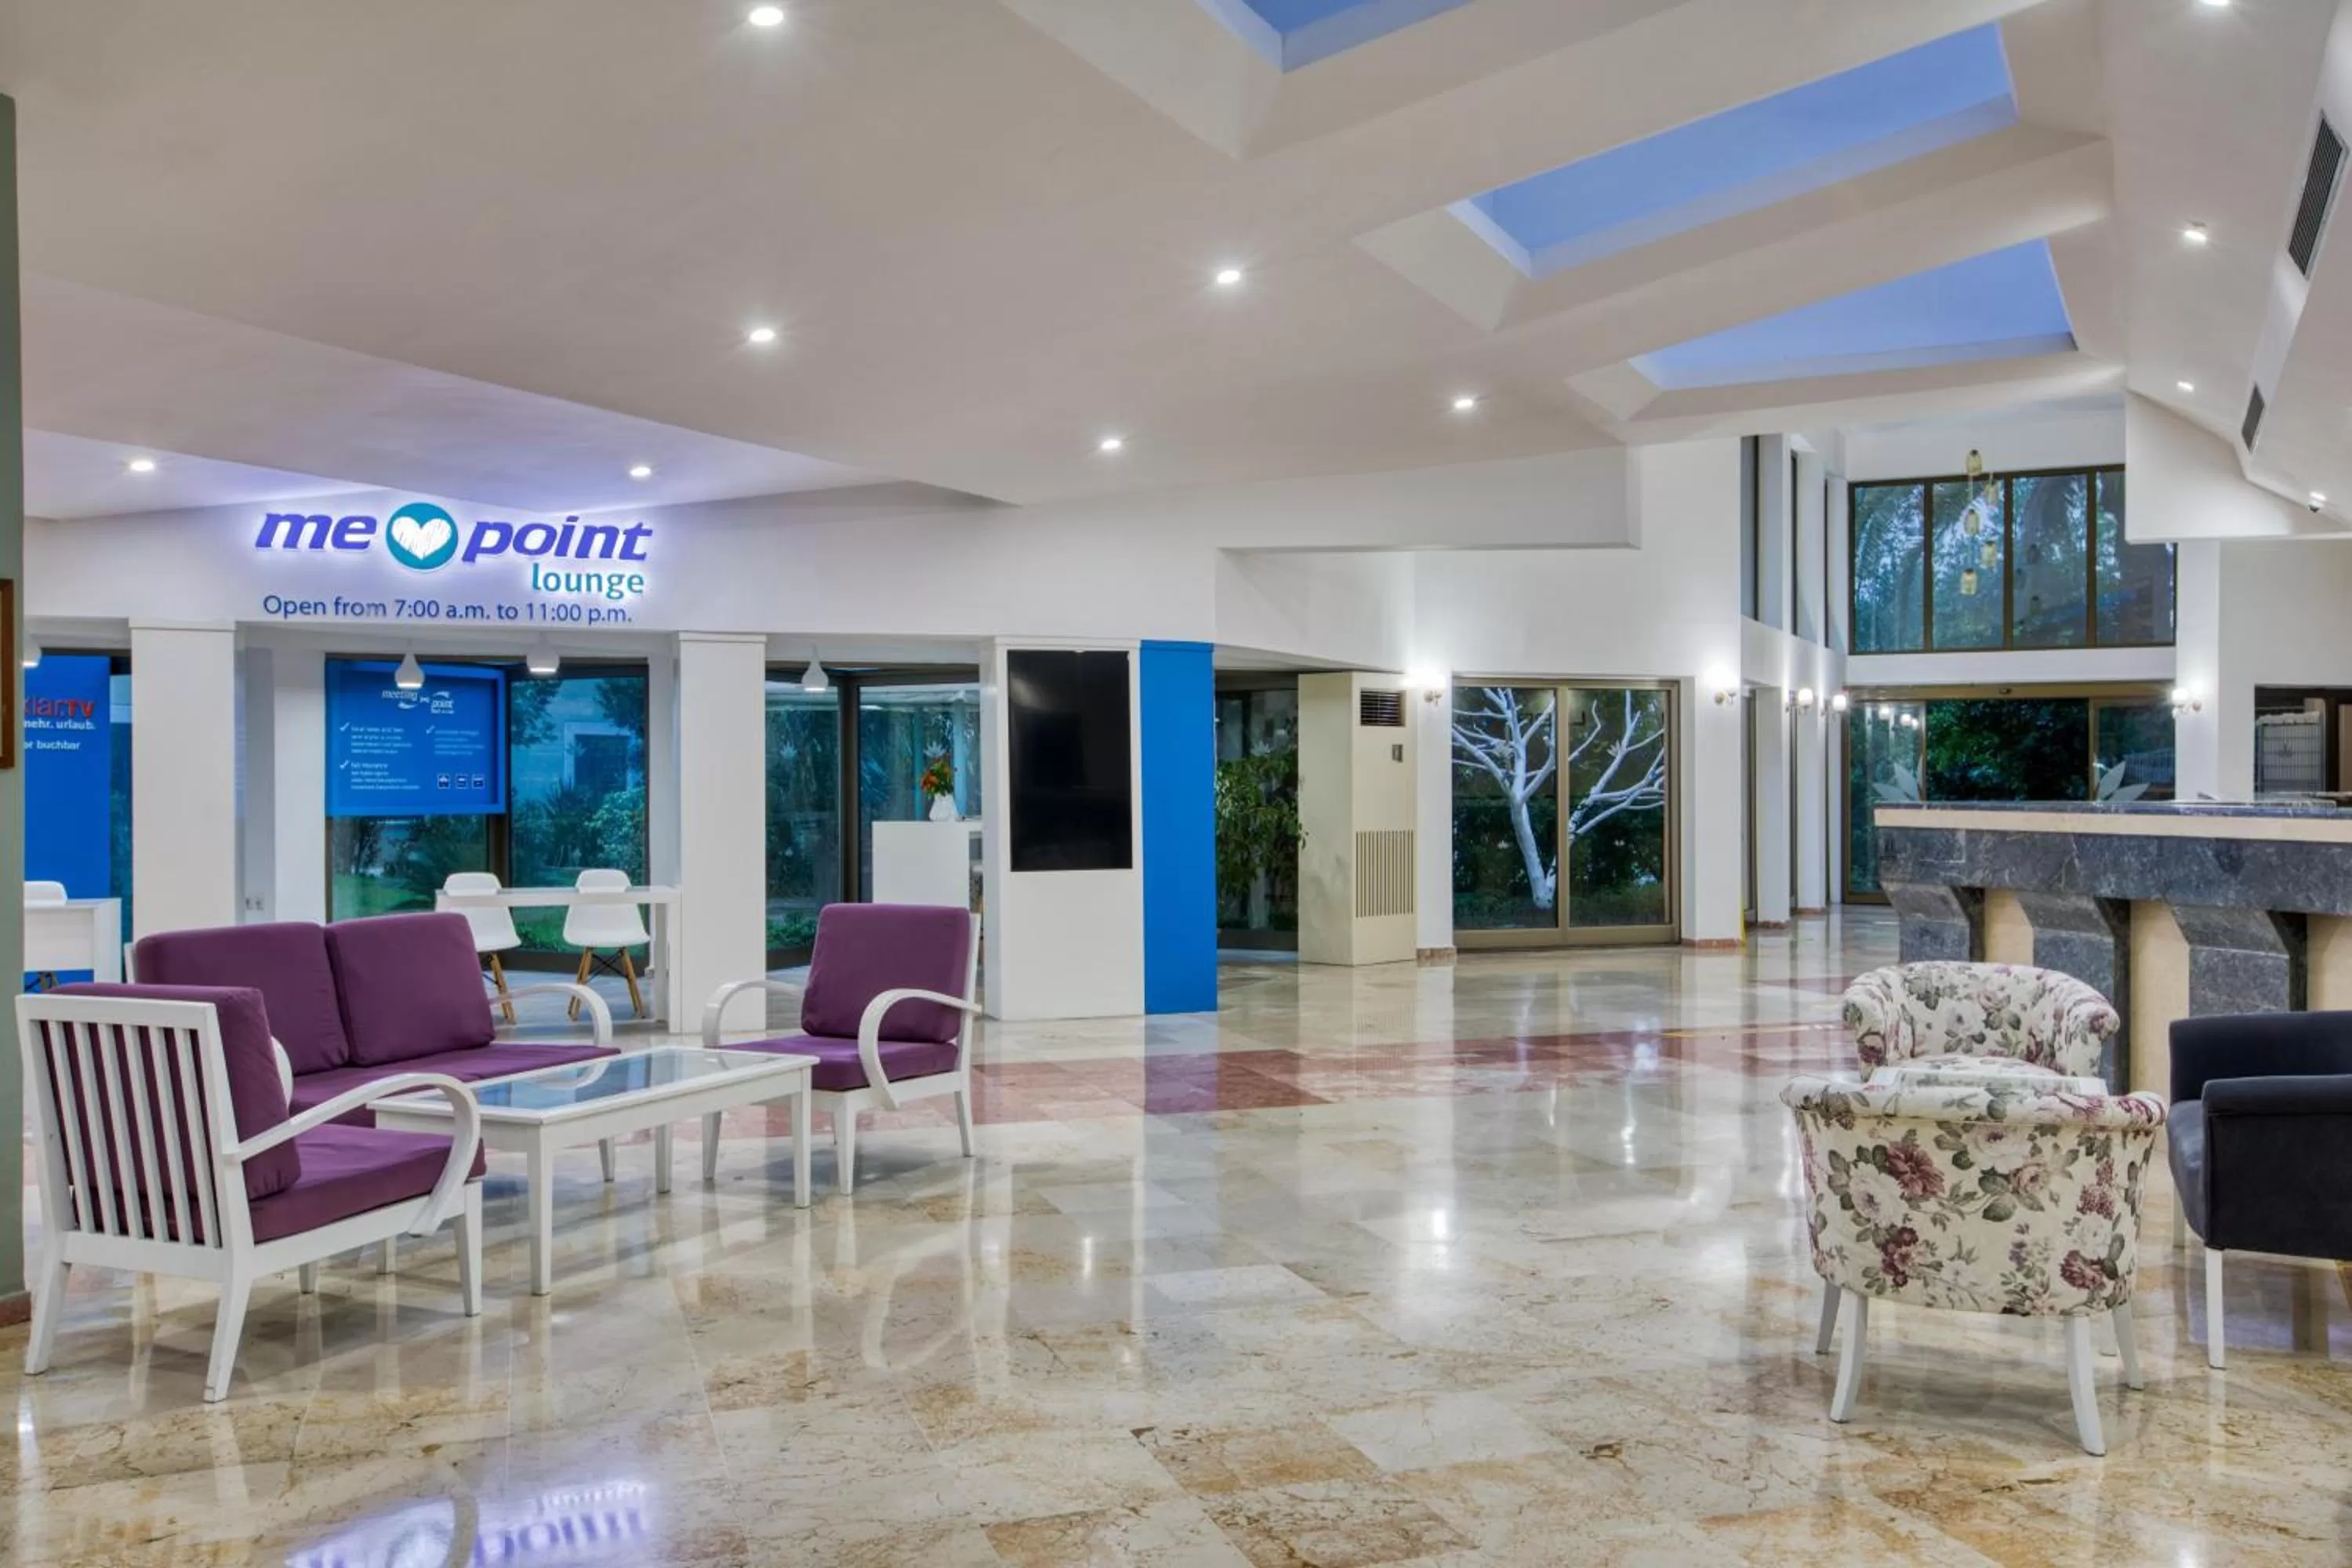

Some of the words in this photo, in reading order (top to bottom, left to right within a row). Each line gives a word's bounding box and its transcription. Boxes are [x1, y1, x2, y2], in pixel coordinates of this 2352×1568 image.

[255, 512, 377, 550] me
[462, 515, 653, 563] point
[532, 562, 644, 600] lounge
[263, 594, 327, 619] Open
[334, 596, 387, 617] from
[394, 598, 440, 619] 7:00
[445, 603, 490, 620] a.m.
[497, 603, 518, 620] to
[527, 601, 582, 622] 11:00
[589, 605, 632, 625] p.m.
[56, 718, 96, 730] urlaub.
[37, 740, 81, 750] buchbar
